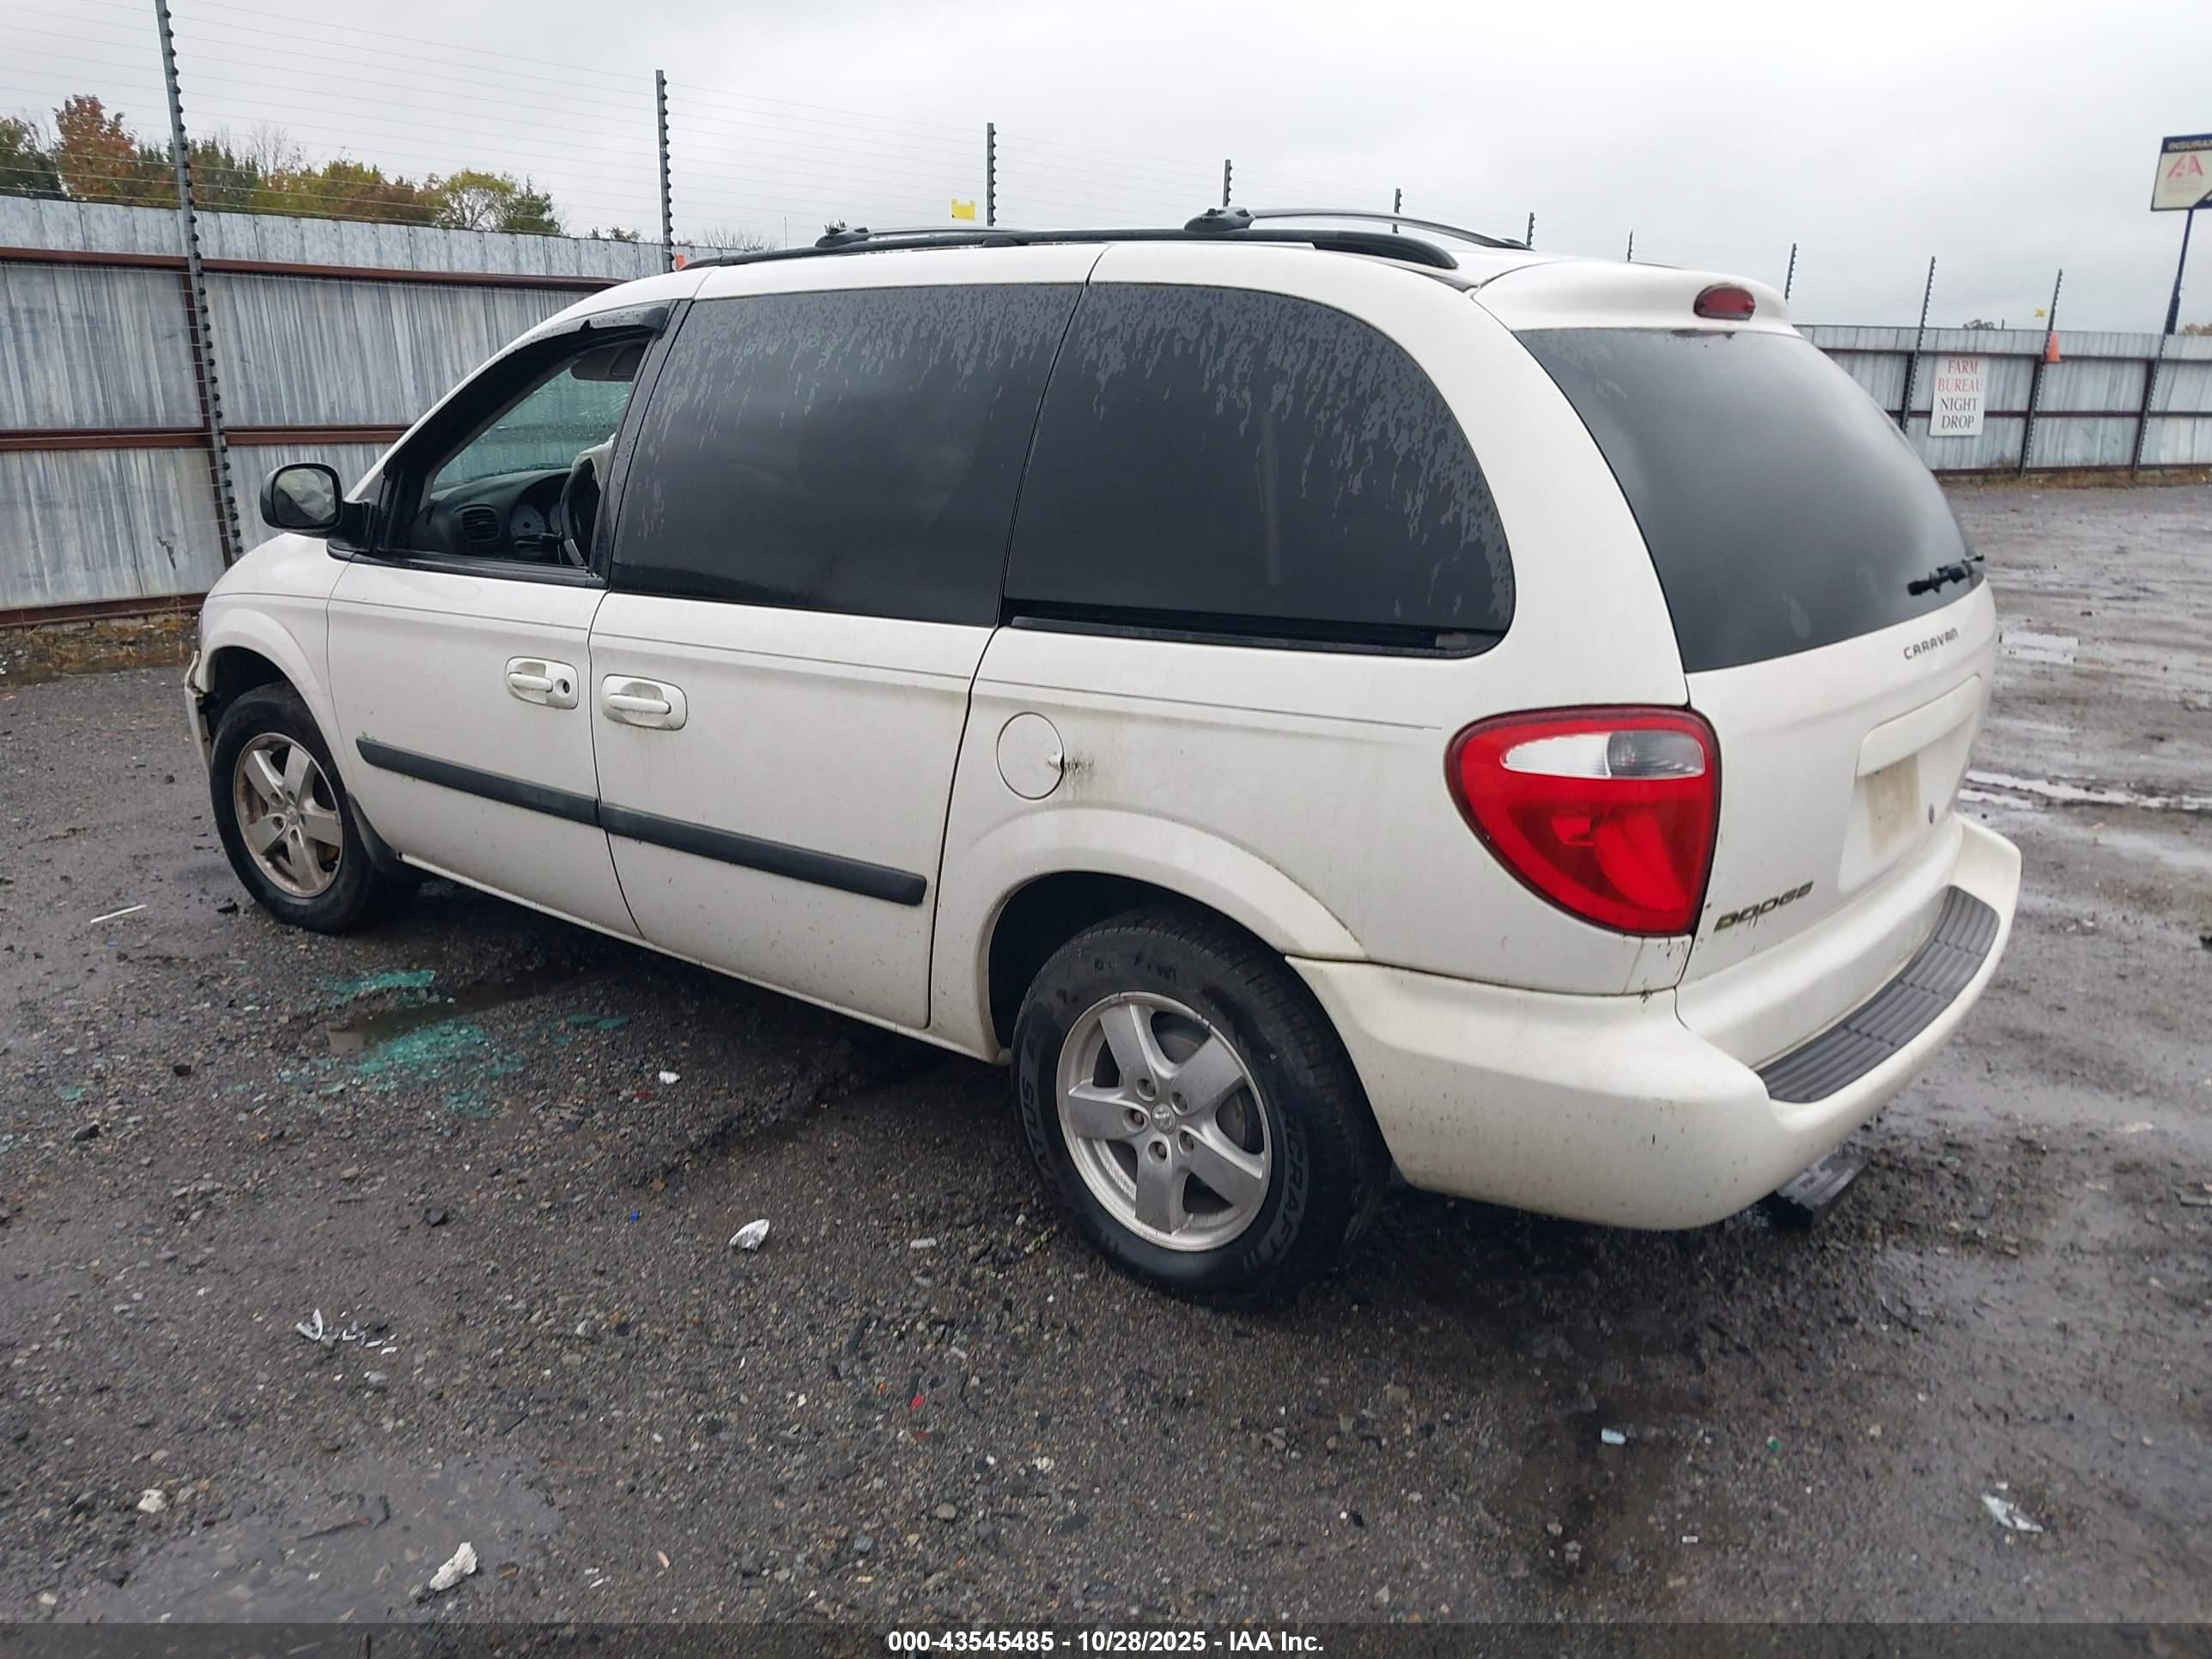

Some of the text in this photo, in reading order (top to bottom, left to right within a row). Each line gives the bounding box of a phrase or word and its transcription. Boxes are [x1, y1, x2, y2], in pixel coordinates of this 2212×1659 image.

[1947, 359, 1979, 375] FARM
[1939, 397, 1979, 412] NIGHT
[1941, 415, 1975, 429] DROP
[1903, 628, 1959, 660] CARAVAN
[1714, 880, 1814, 933] DODGE
